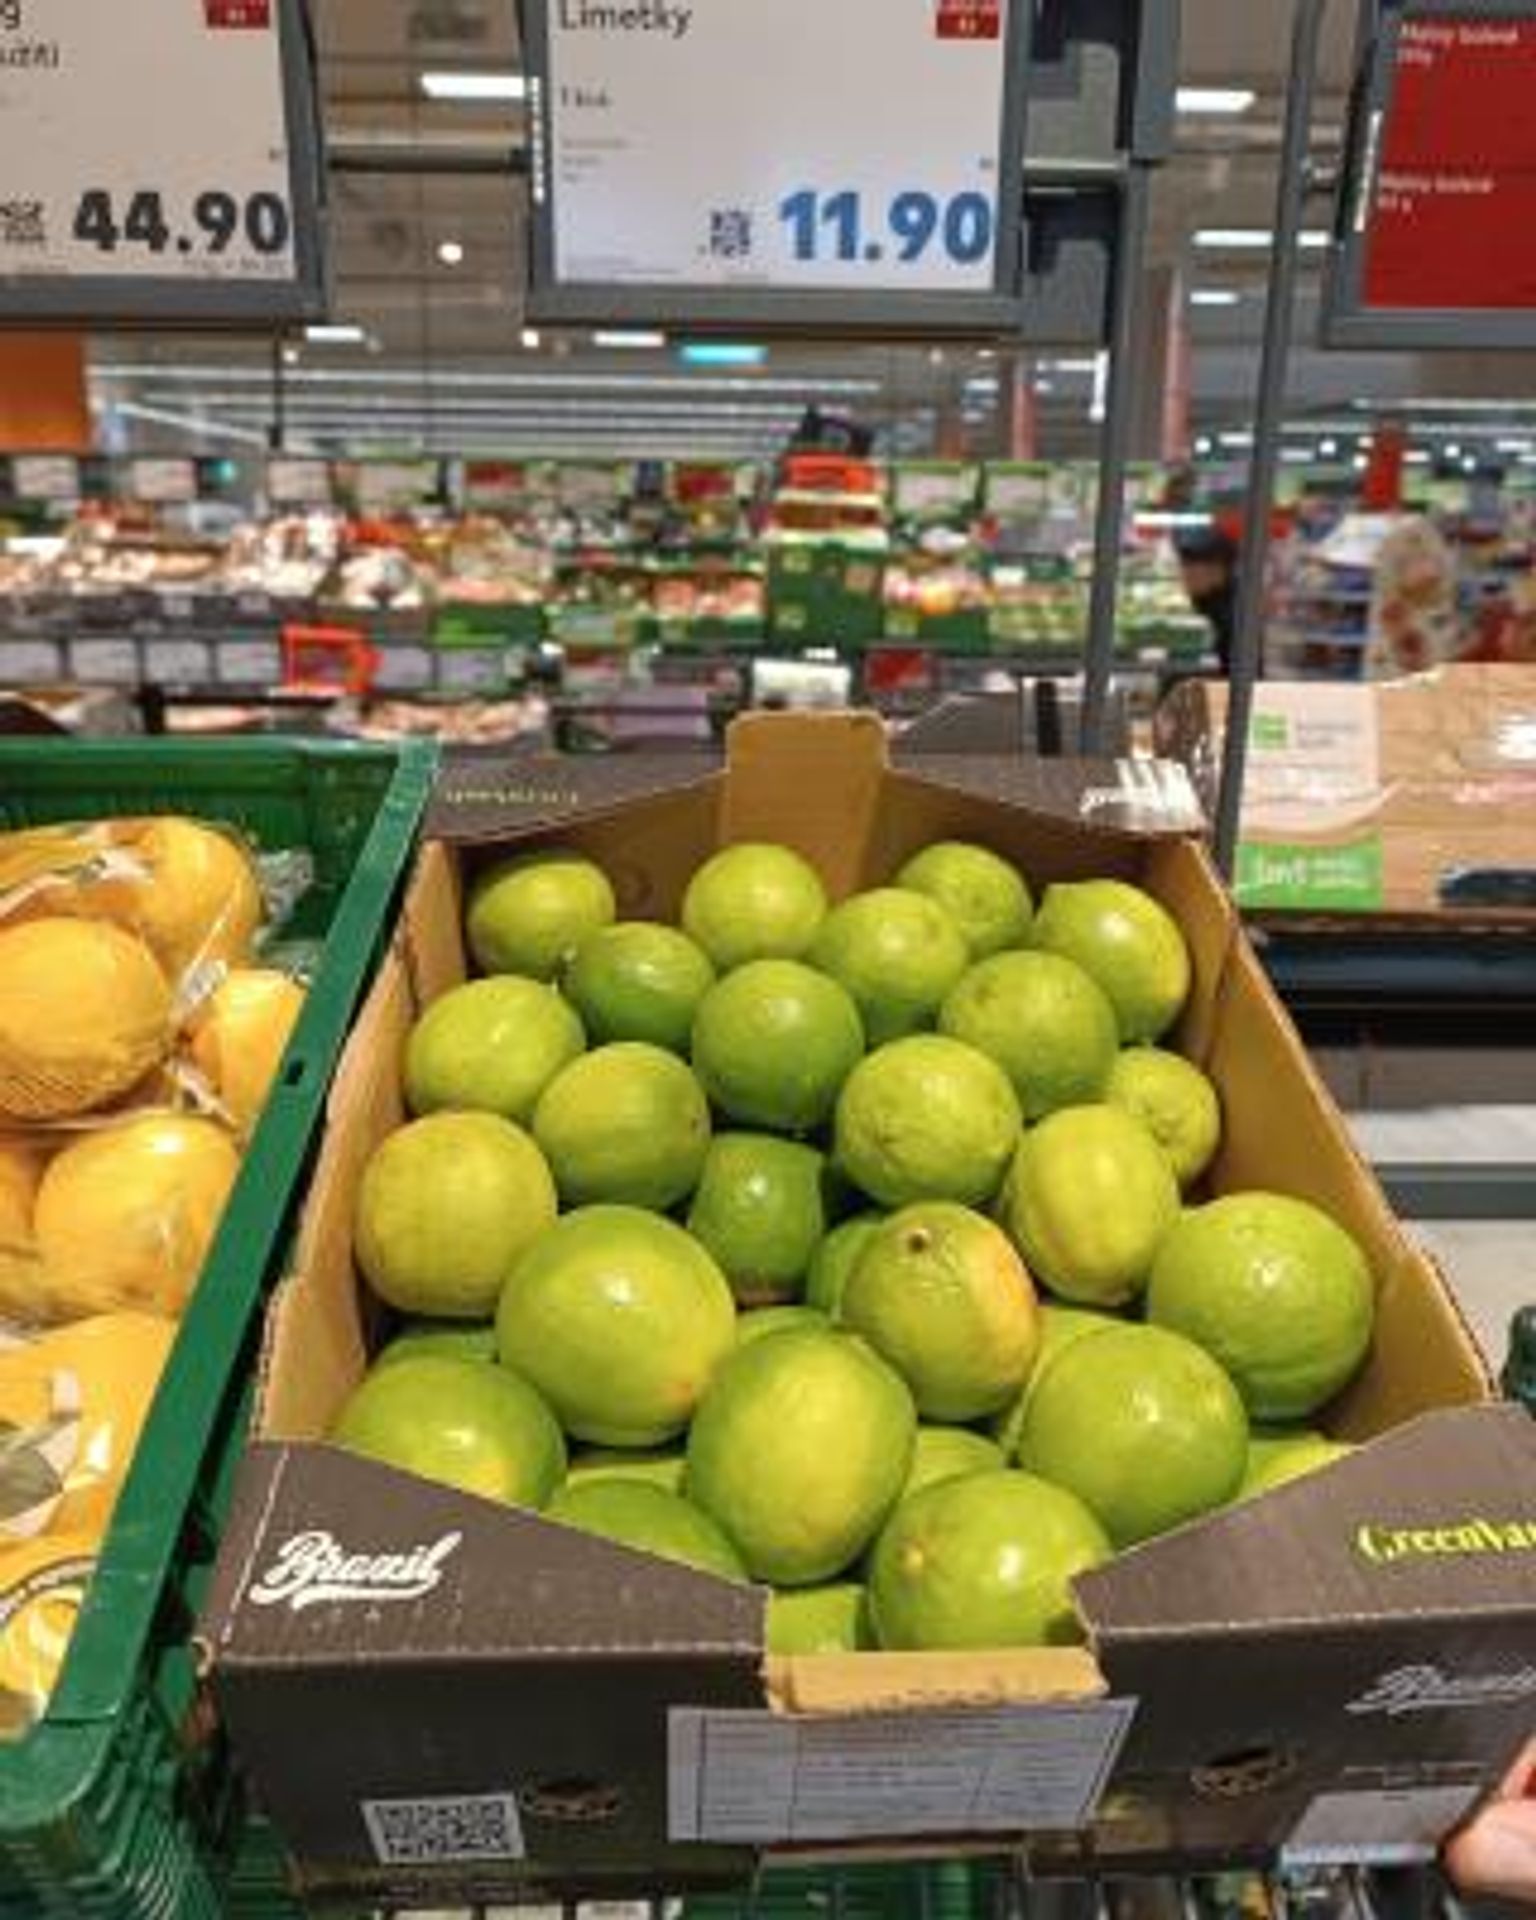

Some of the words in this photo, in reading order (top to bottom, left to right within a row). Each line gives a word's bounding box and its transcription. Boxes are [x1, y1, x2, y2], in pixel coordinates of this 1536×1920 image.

[559, 0, 693, 39] Limetky
[73, 189, 289, 253] 44.90
[778, 191, 991, 262] 11.90
